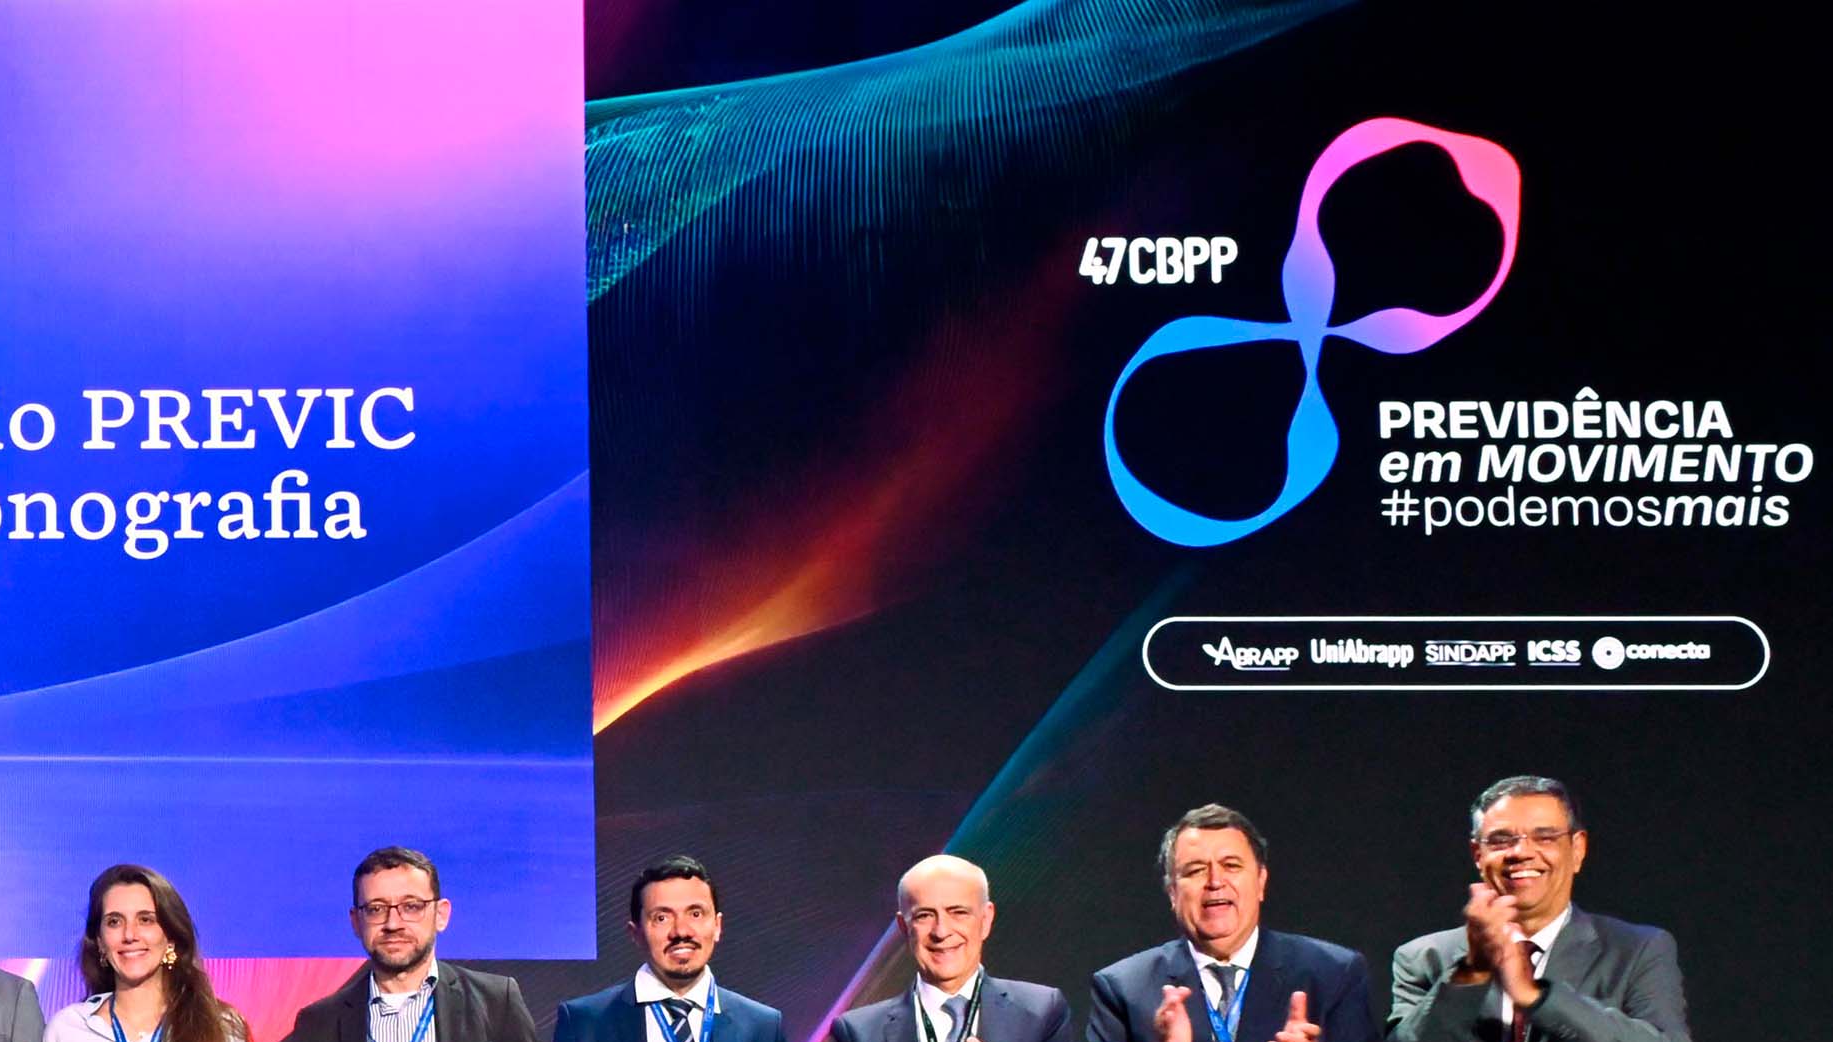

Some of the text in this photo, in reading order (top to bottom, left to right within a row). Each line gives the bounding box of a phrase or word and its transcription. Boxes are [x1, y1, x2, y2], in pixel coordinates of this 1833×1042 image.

[1078, 236, 1238, 285] 47CBPP
[82, 387, 416, 450] PREVIC
[1379, 386, 1734, 439] PREVIDÊNCIA
[1379, 443, 1815, 483] em MOVIMENTO
[1381, 484, 1790, 536] #podemosmais
[1310, 638, 1415, 668] UniAbrapp
[1425, 643, 1517, 663] SINDAPP
[1527, 639, 1582, 662] ICSS
[1625, 641, 1711, 660] conecta
